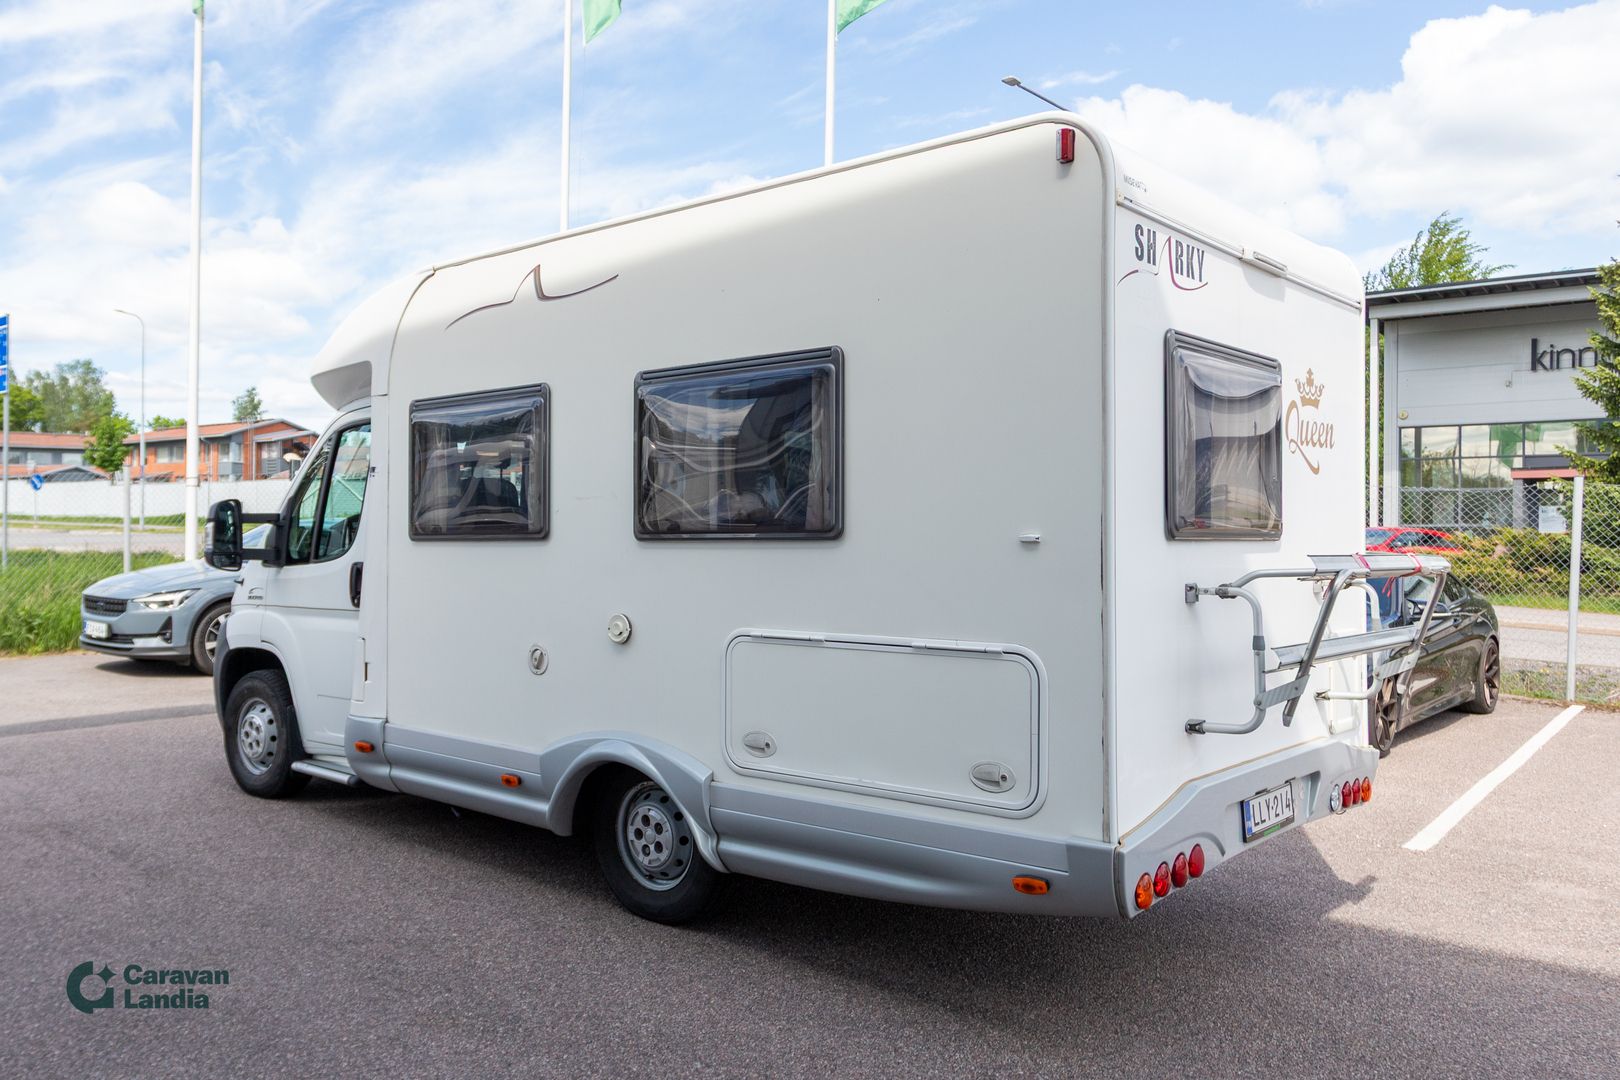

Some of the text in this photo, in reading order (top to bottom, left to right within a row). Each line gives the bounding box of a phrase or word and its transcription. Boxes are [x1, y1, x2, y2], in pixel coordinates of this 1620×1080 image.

[1530, 337, 1602, 373] kinn
[1285, 399, 1335, 475] Queen
[1252, 790, 1292, 827] LLY-214
